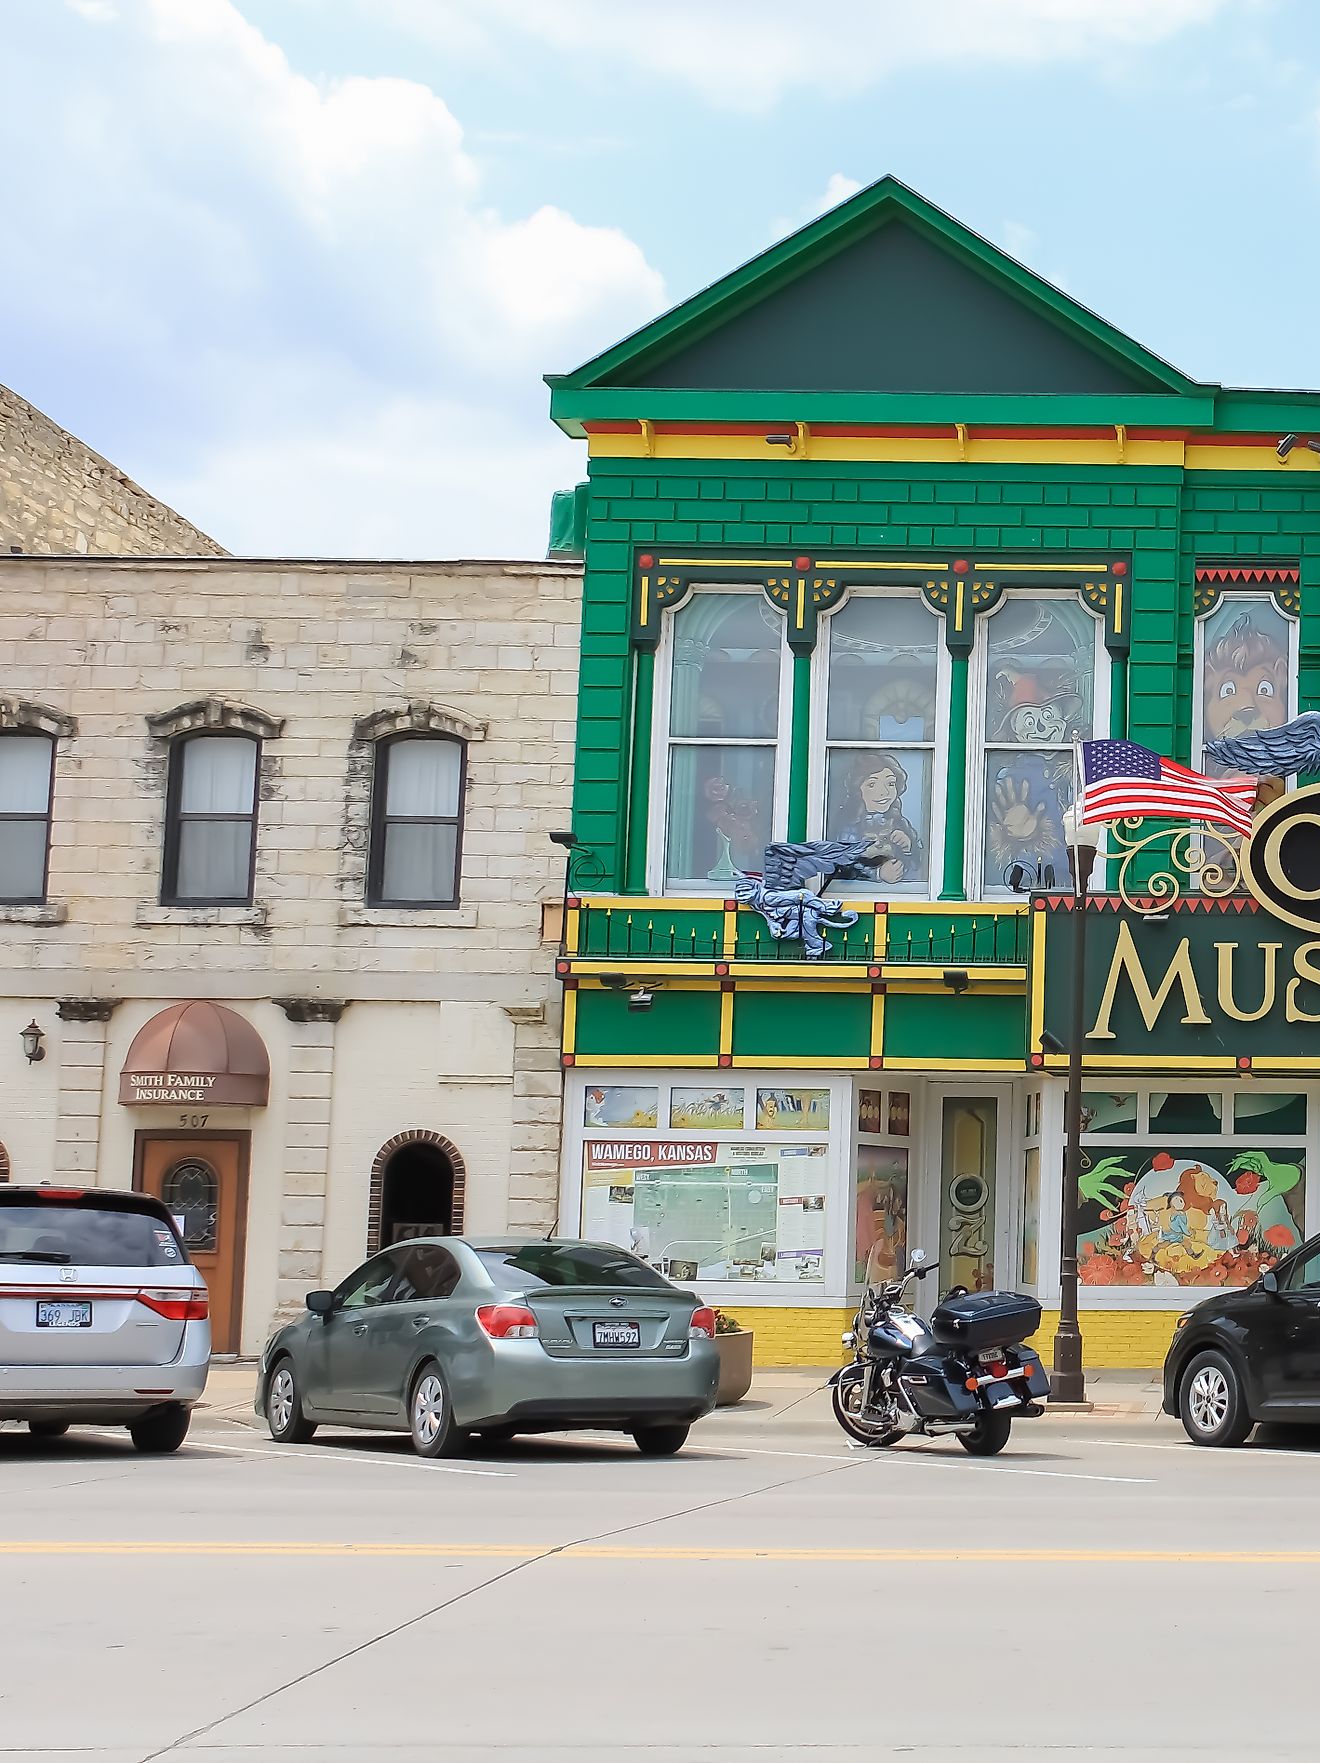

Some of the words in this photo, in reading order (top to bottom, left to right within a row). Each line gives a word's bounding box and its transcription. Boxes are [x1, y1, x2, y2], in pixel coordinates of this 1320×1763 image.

[130, 1074, 163, 1087] SMITH
[167, 1074, 216, 1087] FAMILY
[136, 1088, 205, 1100] INSURANCE
[179, 1114, 209, 1127] 507
[591, 1143, 655, 1163] WAMEGO,
[658, 1145, 713, 1162] KANSAS
[40, 1309, 61, 1322] 369
[597, 1331, 638, 1344] 7MHW592
